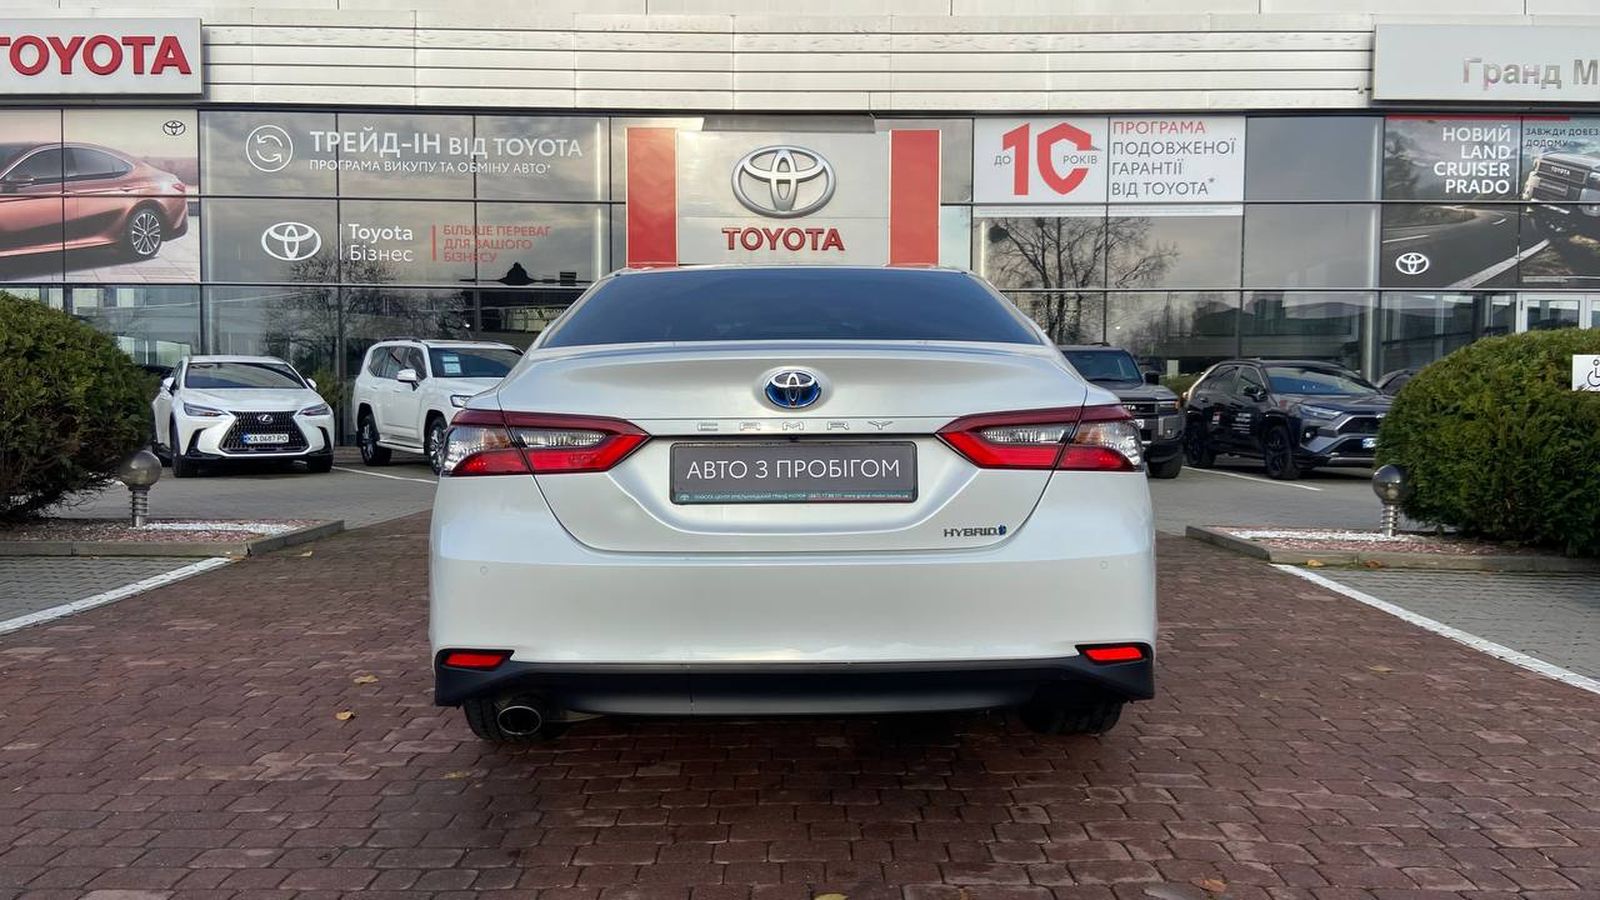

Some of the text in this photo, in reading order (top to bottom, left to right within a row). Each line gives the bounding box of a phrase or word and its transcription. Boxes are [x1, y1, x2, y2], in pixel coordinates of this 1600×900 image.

[1462, 57, 1562, 90] Гранд
[1112, 121, 1206, 135] ПРОГРАМА
[1442, 124, 1511, 142] НОВИЙ
[1525, 128, 1567, 137] ЗАВЖДИ
[309, 126, 583, 159] ТРЕЙД-ІН ВІД TOYOTA
[1112, 138, 1236, 157] ПОДОВЖЕНОЇ
[1525, 139, 1568, 148] ДОДОМУ
[1461, 145, 1511, 159] LAND
[309, 159, 381, 171] ПРОГРАМА
[384, 160, 437, 173] ВИКУПУ
[440, 161, 455, 172] ТА
[457, 162, 510, 174] ОБМІНУ
[994, 155, 1011, 166] ДО
[1063, 155, 1098, 165] РОКІВ
[1112, 158, 1184, 175] ГАРАНТІЇ
[1433, 162, 1511, 176] CRUISER
[1111, 182, 1138, 198] ВІД
[1445, 179, 1510, 194] PRADO
[348, 223, 413, 244] Toyota
[443, 224, 552, 237] БІЛЬШЕ ПЕРЕВАГ
[443, 238, 533, 250] ДЛЯ ВАШОГО
[721, 227, 845, 251] TOYOTA
[349, 244, 414, 262] Бізнес
[443, 252, 497, 263] БІЗНЕСУ
[686, 459, 901, 479] АВТО З ПРОБІГОМ
[943, 526, 999, 537] HYBRID
